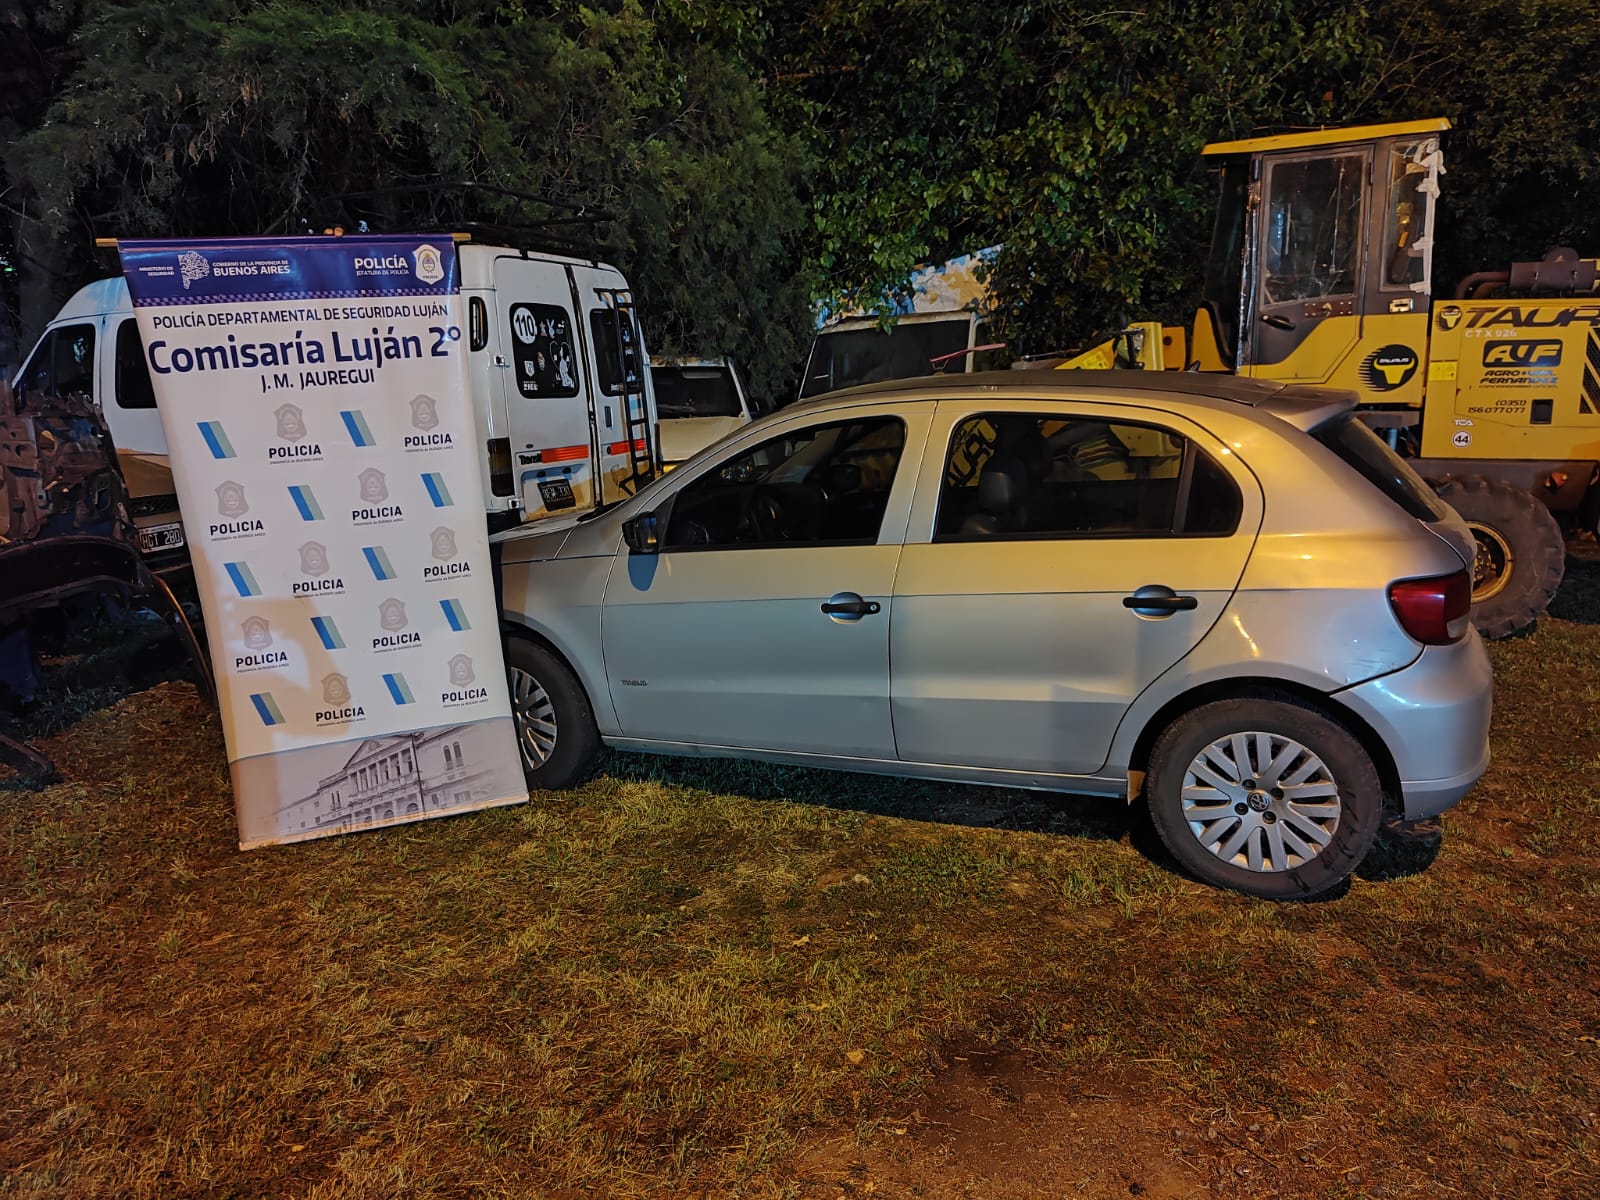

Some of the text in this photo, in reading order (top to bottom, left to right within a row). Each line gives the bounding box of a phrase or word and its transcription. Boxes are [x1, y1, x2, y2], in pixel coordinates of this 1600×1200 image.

[354, 254, 408, 269] POLICÍA
[213, 265, 291, 277] BUENOS AIRES
[153, 301, 448, 329] POLICÍA DEPARTAMENTAL DE SEGURIDAD LUJÁN
[515, 315, 535, 337] 110
[1496, 329, 1517, 337] 926
[148, 330, 325, 374] Comisaría
[331, 326, 422, 369] Luján
[261, 368, 375, 393] J. M. JAUREGUI
[404, 433, 452, 447] POLICIA
[1455, 435, 1469, 444] 44
[269, 444, 322, 459] POLICIA
[352, 506, 402, 521] POLICIA
[210, 520, 264, 536] POLICIA
[142, 533, 159, 549] HGT
[424, 562, 470, 578] POLICIA
[293, 578, 344, 594] POLICIA
[373, 632, 421, 649] POLICIA
[236, 651, 288, 668] POLICIA
[442, 687, 487, 703] POLICIA
[316, 706, 365, 722] POLICIA
